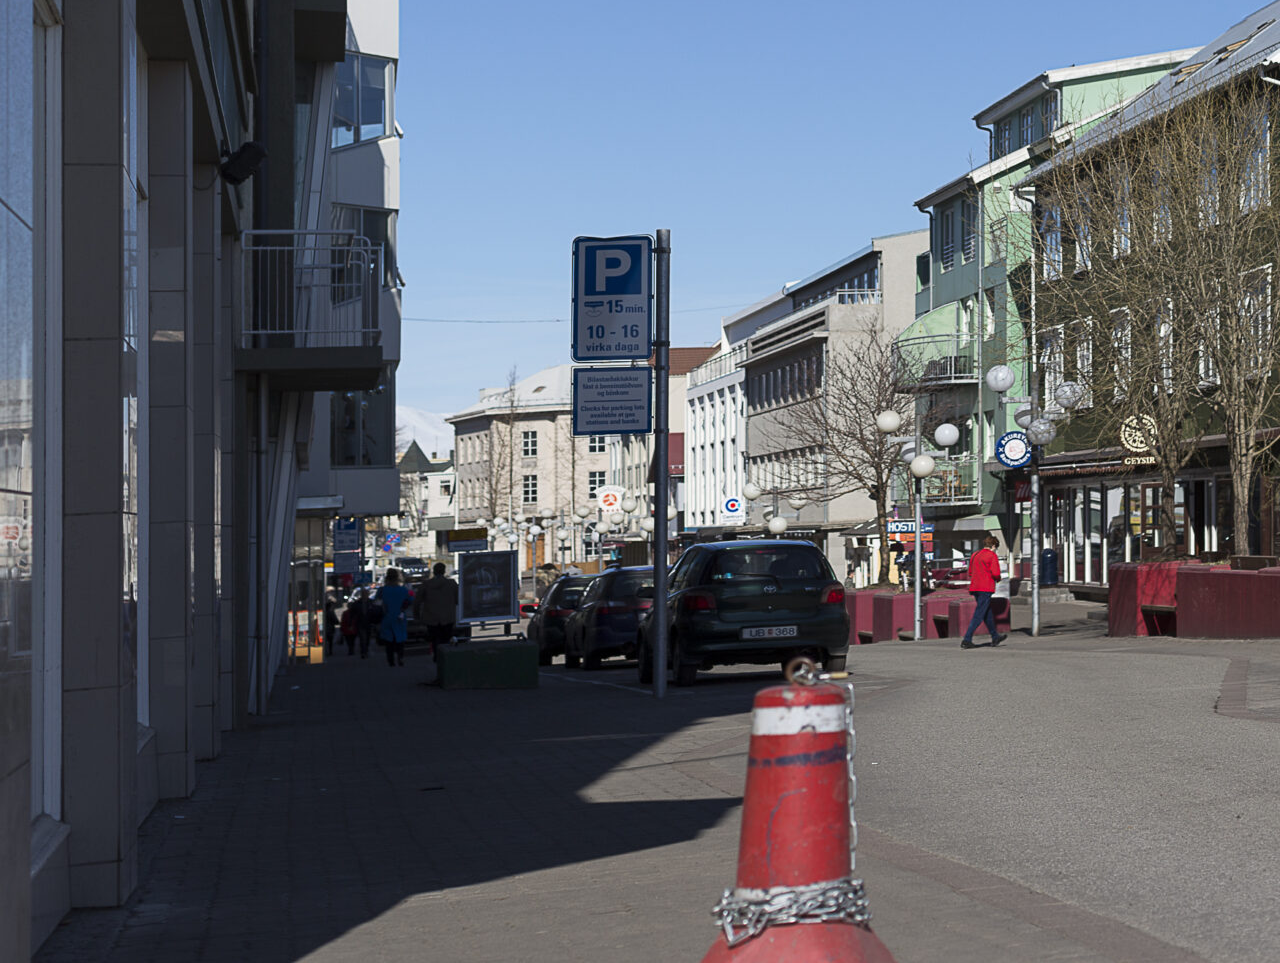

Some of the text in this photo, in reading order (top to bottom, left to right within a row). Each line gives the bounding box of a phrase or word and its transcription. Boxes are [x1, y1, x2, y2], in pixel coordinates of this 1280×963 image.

[596, 249, 632, 292] P
[606, 300, 646, 314] 15 min.
[586, 325, 604, 339] 10
[622, 324, 639, 338] 16
[586, 342, 639, 353] virka daga
[1001, 433, 1028, 445] AKUREYR
[1124, 456, 1156, 465] GEYSIR
